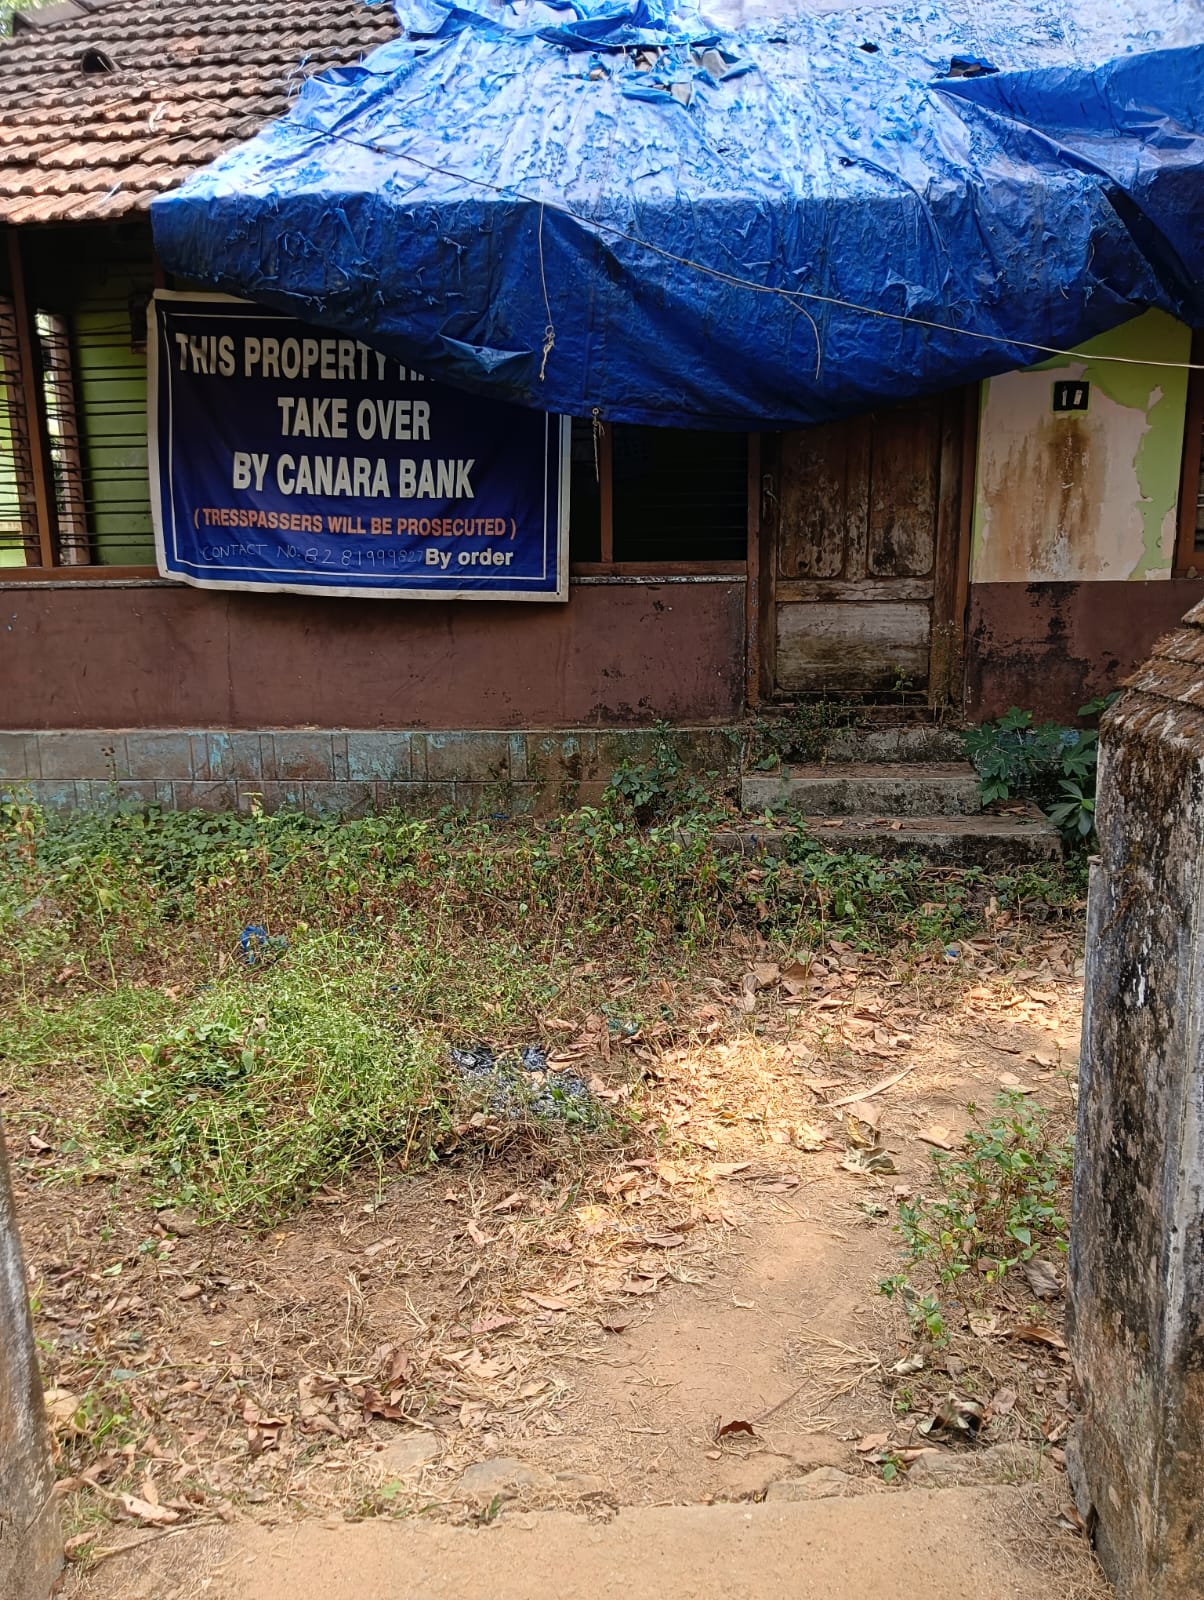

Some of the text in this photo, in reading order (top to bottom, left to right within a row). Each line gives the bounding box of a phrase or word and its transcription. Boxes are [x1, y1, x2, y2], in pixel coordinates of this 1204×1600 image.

[175, 333, 235, 375] THIS
[244, 337, 387, 381] PROPERTY
[277, 397, 431, 441] TAKE OVER
[232, 451, 475, 499] BY CANARA BANK
[327, 517, 367, 535] WILL
[370, 518, 393, 535] BE
[199, 543, 269, 561] CONTACT
[425, 548, 514, 569] By order
